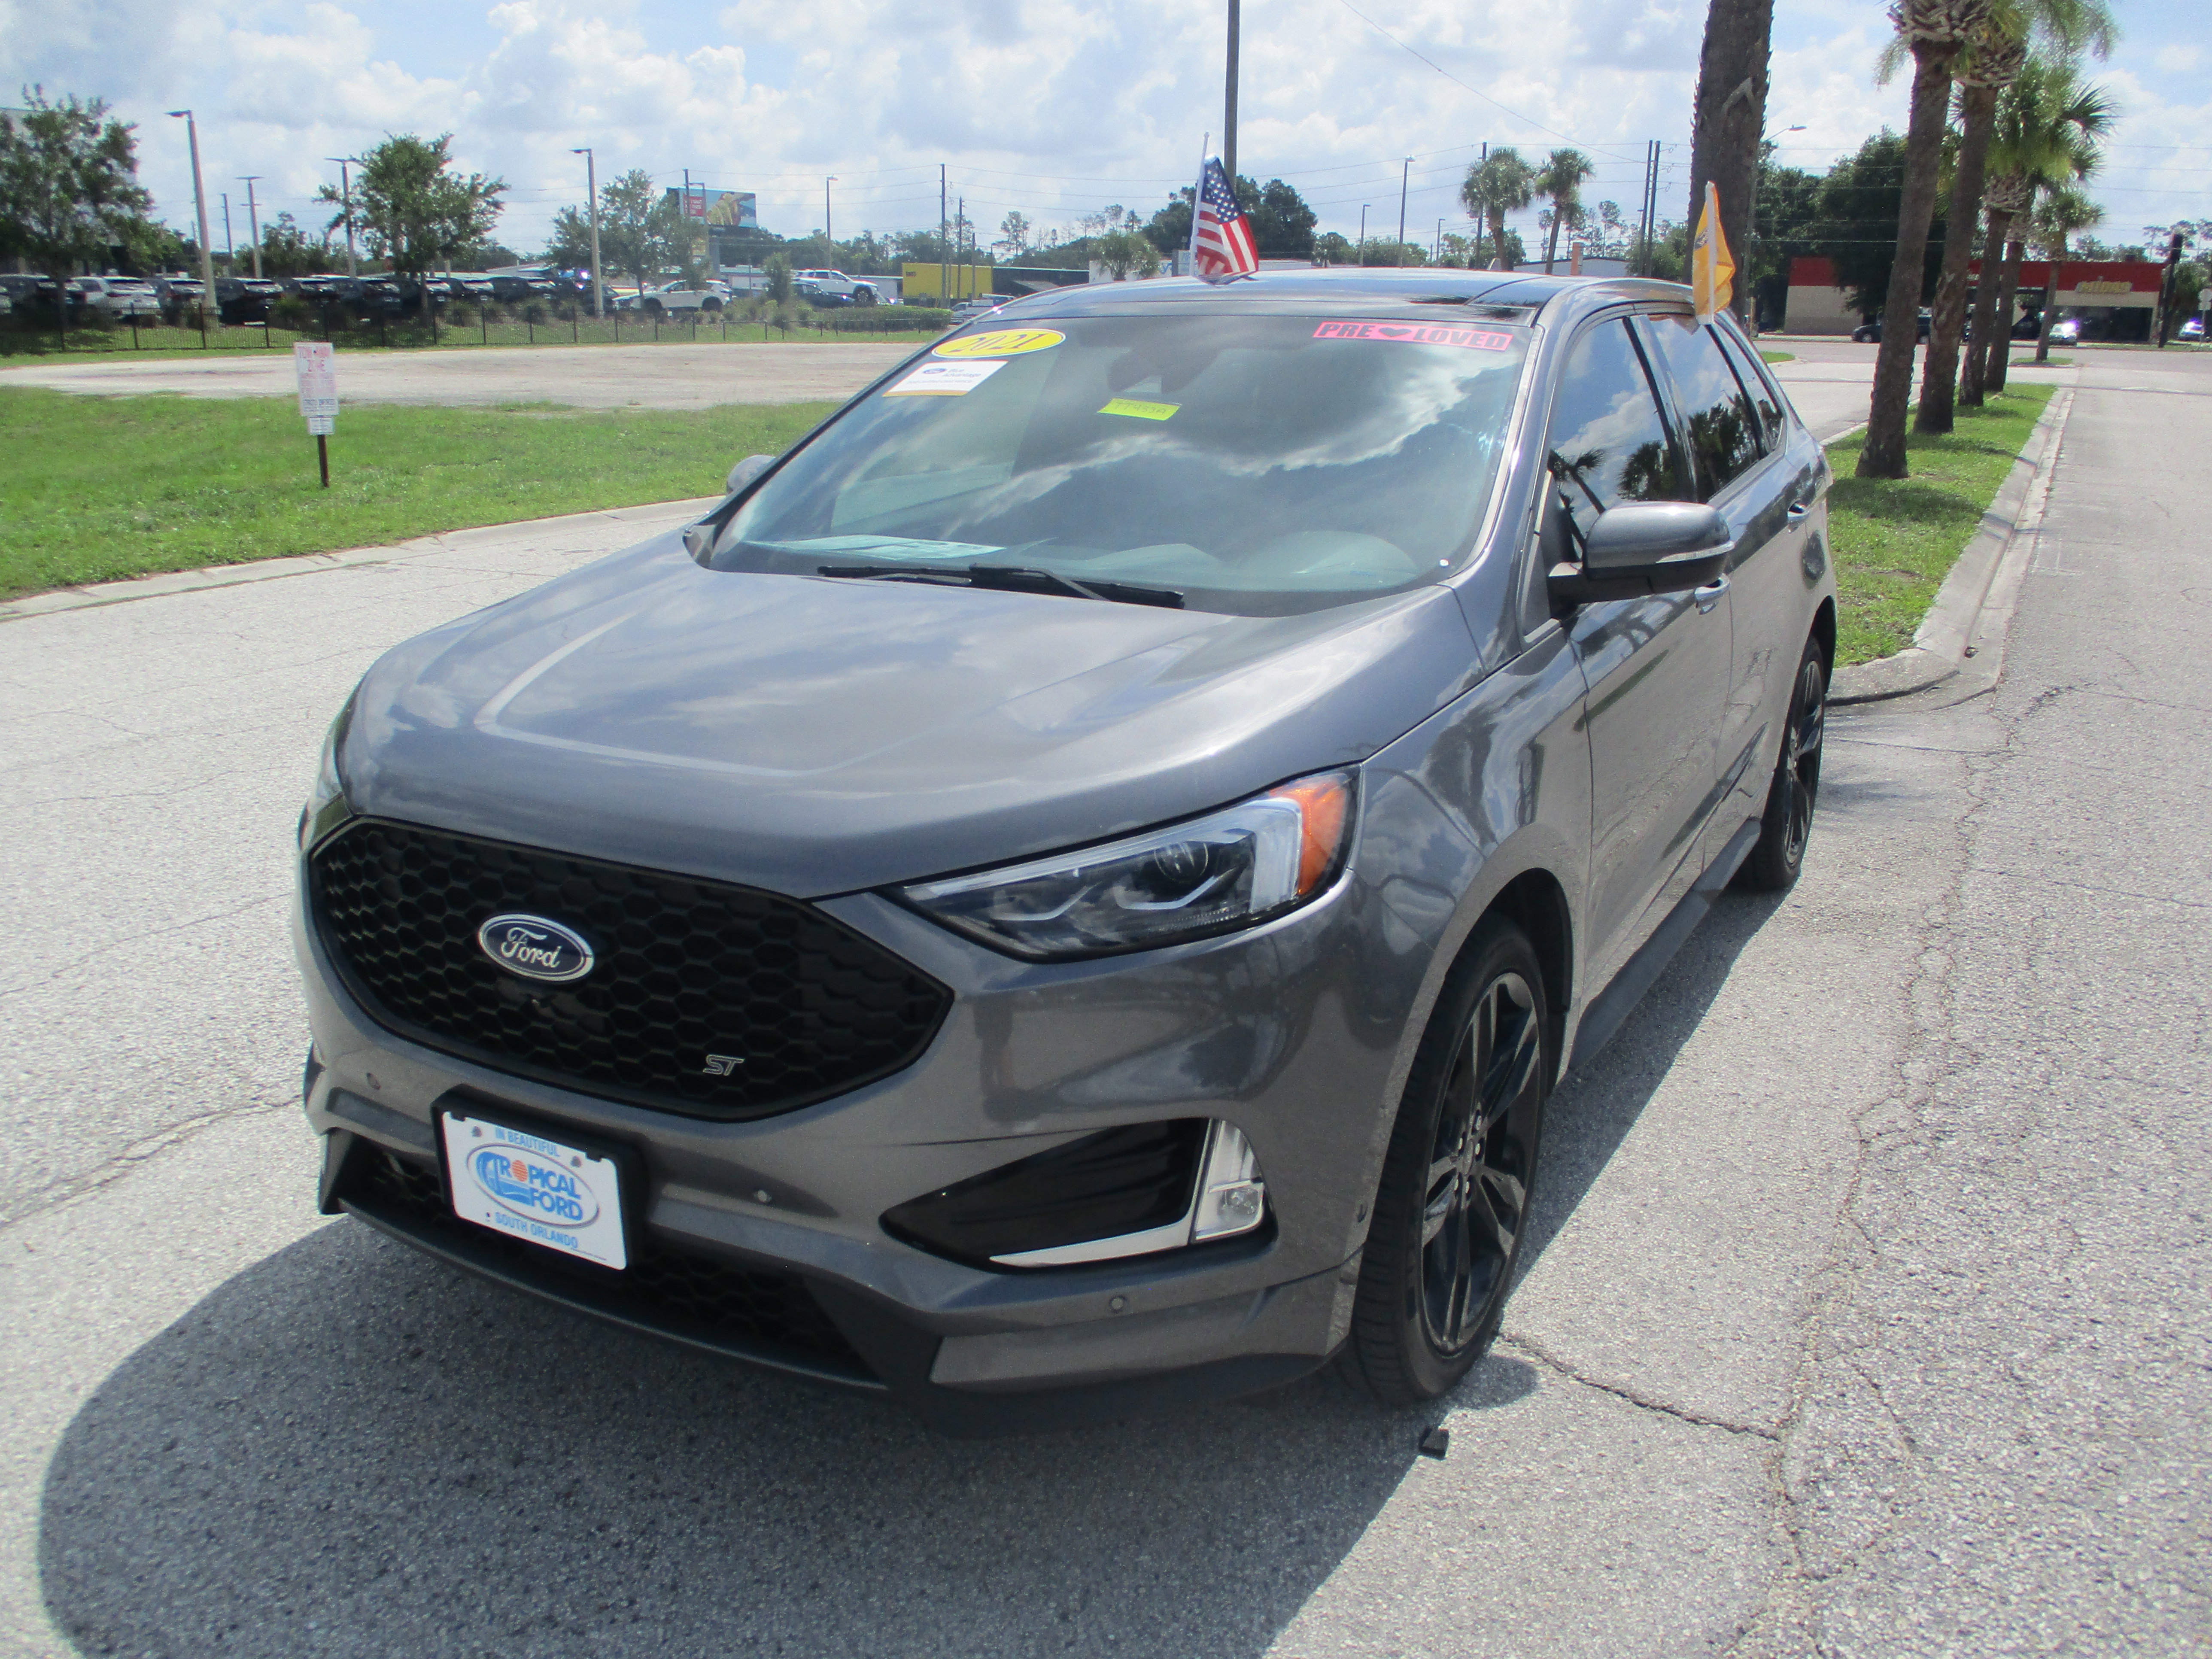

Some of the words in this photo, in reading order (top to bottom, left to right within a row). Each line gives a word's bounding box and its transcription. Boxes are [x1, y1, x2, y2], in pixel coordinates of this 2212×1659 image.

[946, 333, 1048, 353] 2021
[1319, 323, 1376, 337] PRE
[1412, 328, 1509, 348] LOVED
[501, 927, 562, 969] Ford
[702, 1054, 746, 1076] ST
[495, 1127, 505, 1140] IN
[507, 1131, 560, 1157] BEAUTIFUL
[529, 1187, 583, 1220] FORD
[495, 1211, 528, 1233] SOUTH
[531, 1223, 578, 1249] ORLANDO
